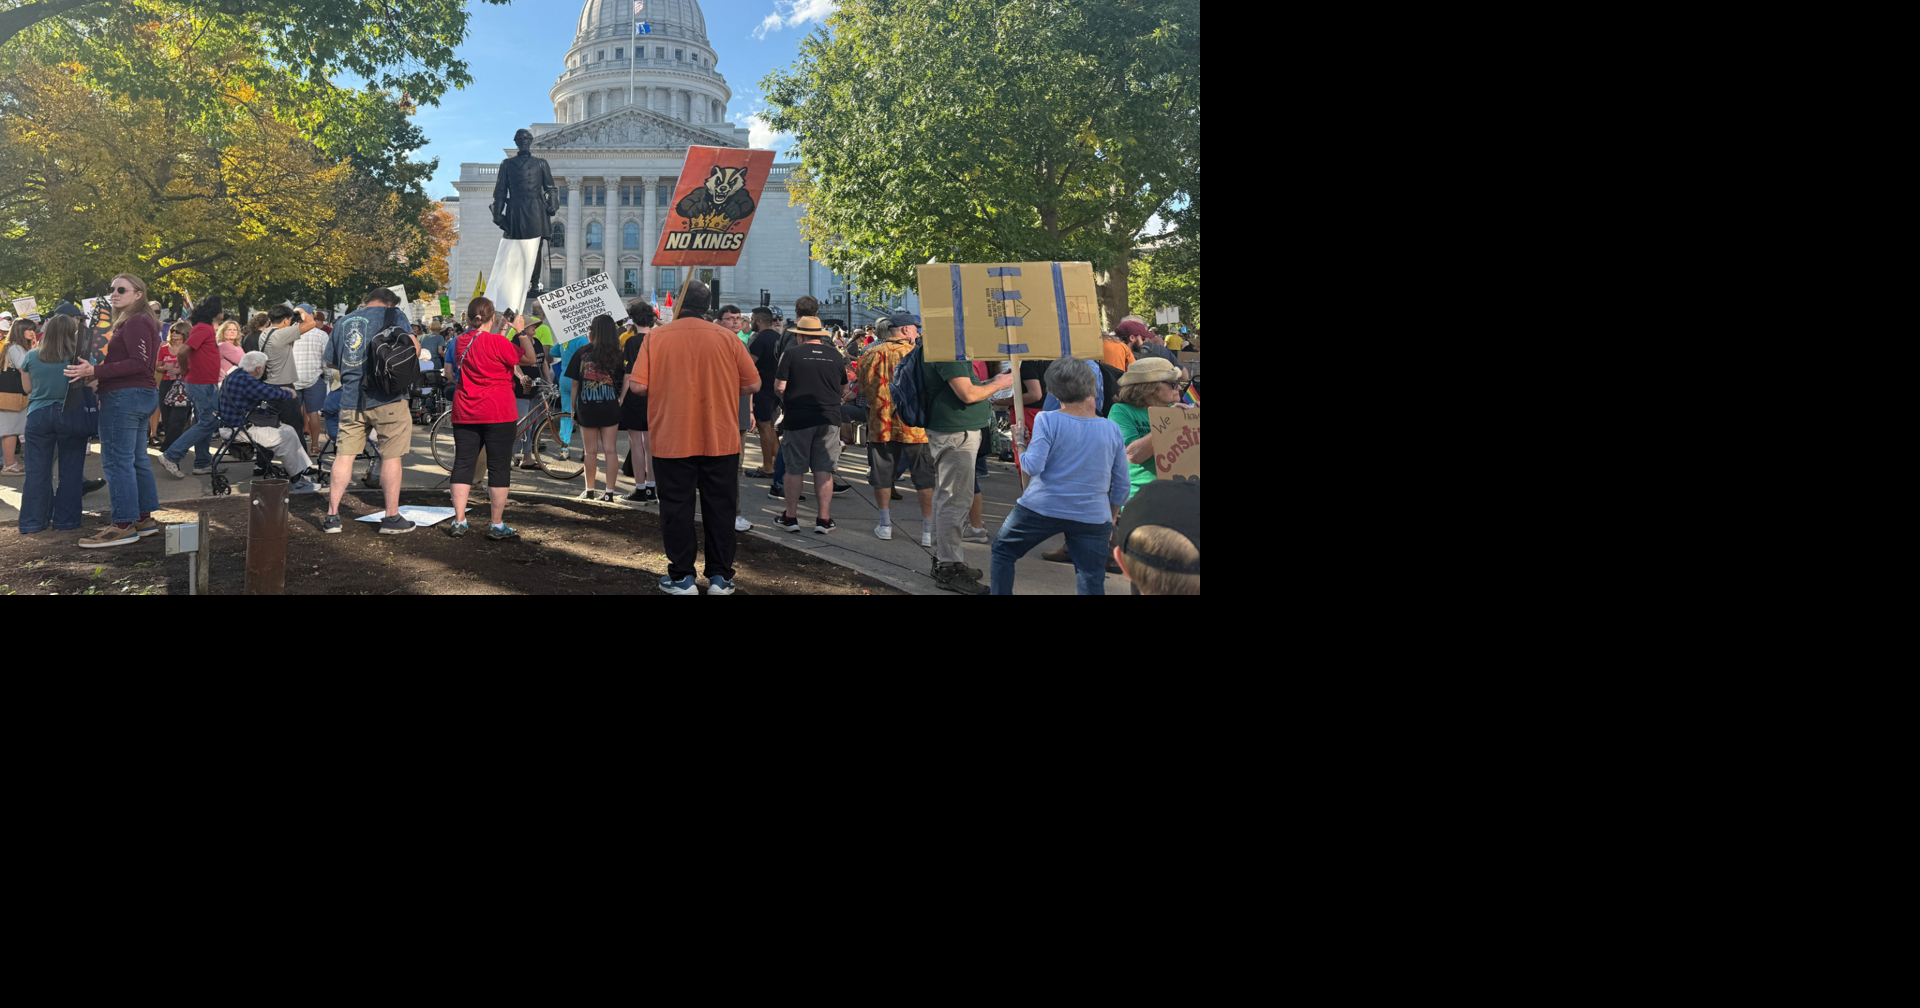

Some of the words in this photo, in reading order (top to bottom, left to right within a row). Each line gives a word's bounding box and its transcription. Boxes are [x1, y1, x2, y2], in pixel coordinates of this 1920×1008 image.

[665, 232, 692, 250] NO
[692, 233, 744, 250] KINGS
[540, 290, 565, 304] FUND
[565, 273, 609, 294] RESEARCH
[547, 298, 567, 310] NEED
[575, 289, 594, 299] CURE
[594, 283, 609, 293] FOR
[559, 296, 602, 315] MEGALOMANIA
[561, 301, 606, 320] INCOMPETENCE
[569, 307, 607, 324] CORRUPTION
[563, 318, 591, 334] STUPIDITY
[1152, 416, 1171, 434] We
